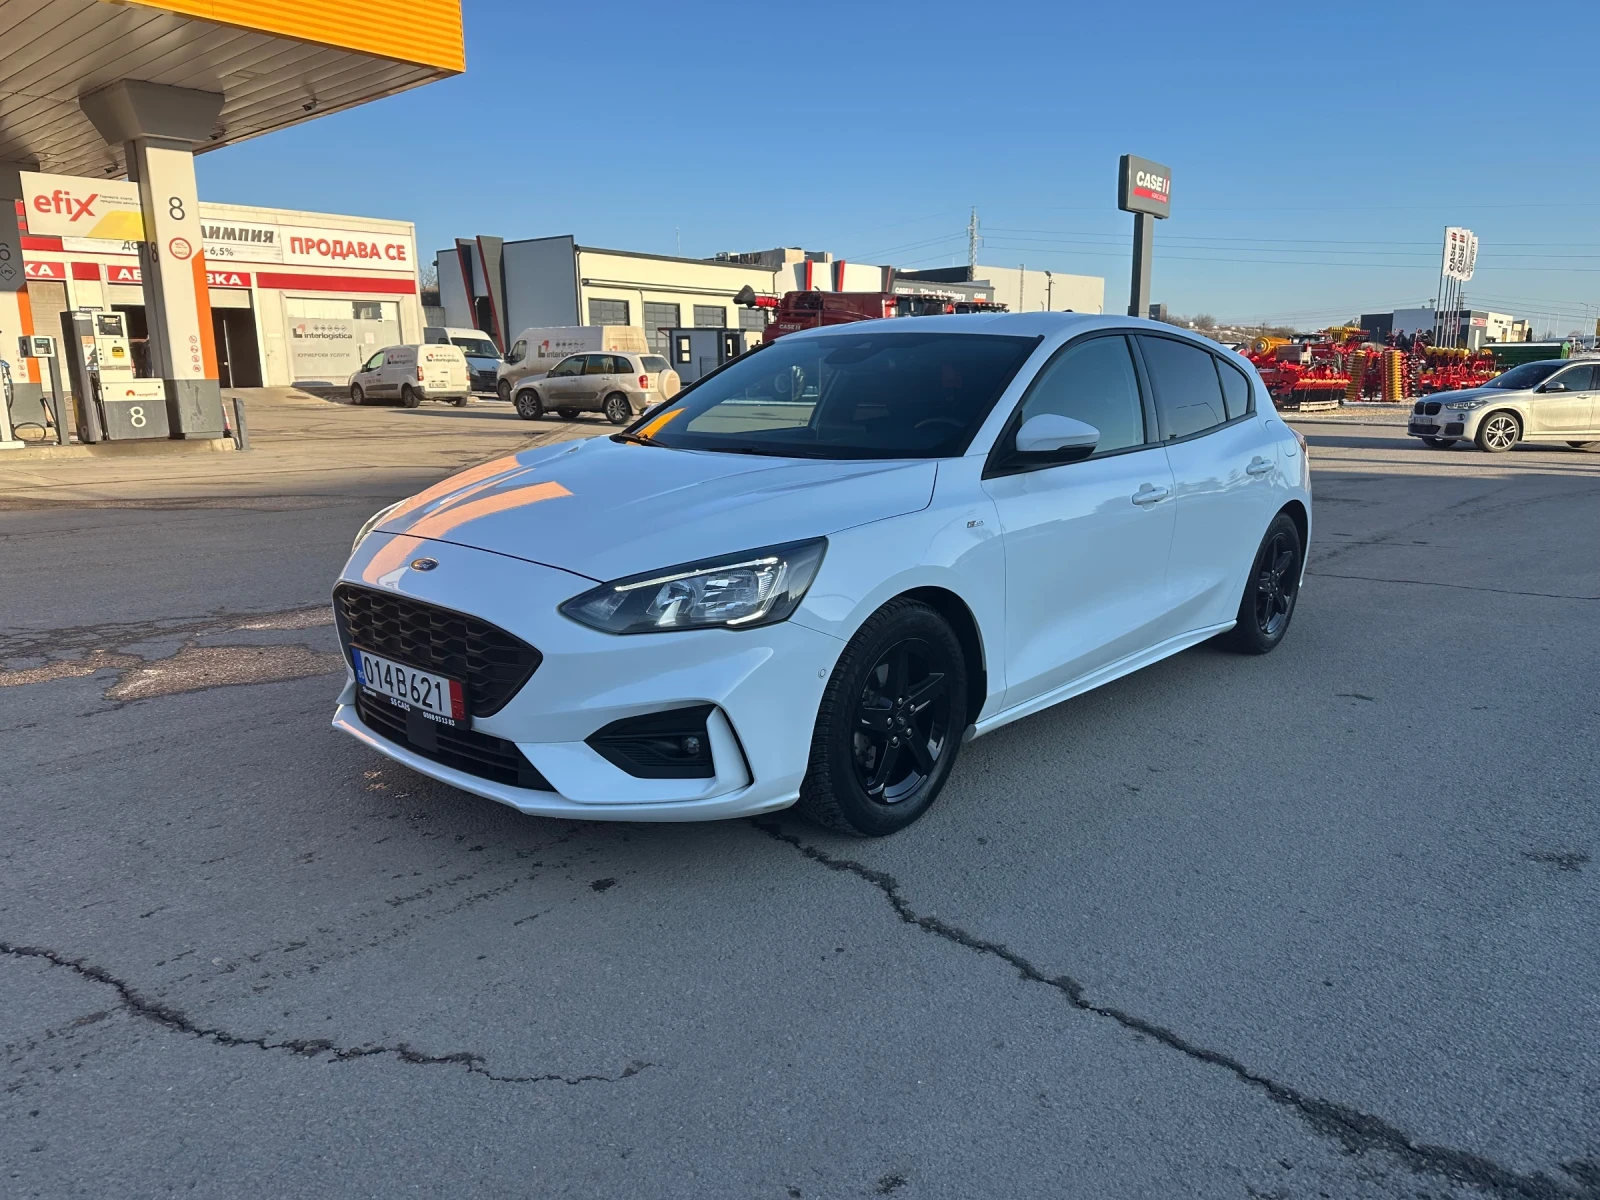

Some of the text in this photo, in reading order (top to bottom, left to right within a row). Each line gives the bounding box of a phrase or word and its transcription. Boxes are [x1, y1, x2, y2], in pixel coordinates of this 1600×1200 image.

[1136, 171, 1163, 192] CASE
[33, 190, 99, 222] efix
[168, 196, 186, 220] 8
[151, 242, 158, 263] 8
[210, 246, 234, 256] 6,5%
[290, 236, 406, 261] ПРОДАВА СЕ
[1449, 243, 1457, 271] CASE
[1456, 245, 1465, 273] CASE
[304, 331, 353, 340] interlogistica
[130, 406, 147, 428] 8
[363, 656, 443, 712] 014B621
